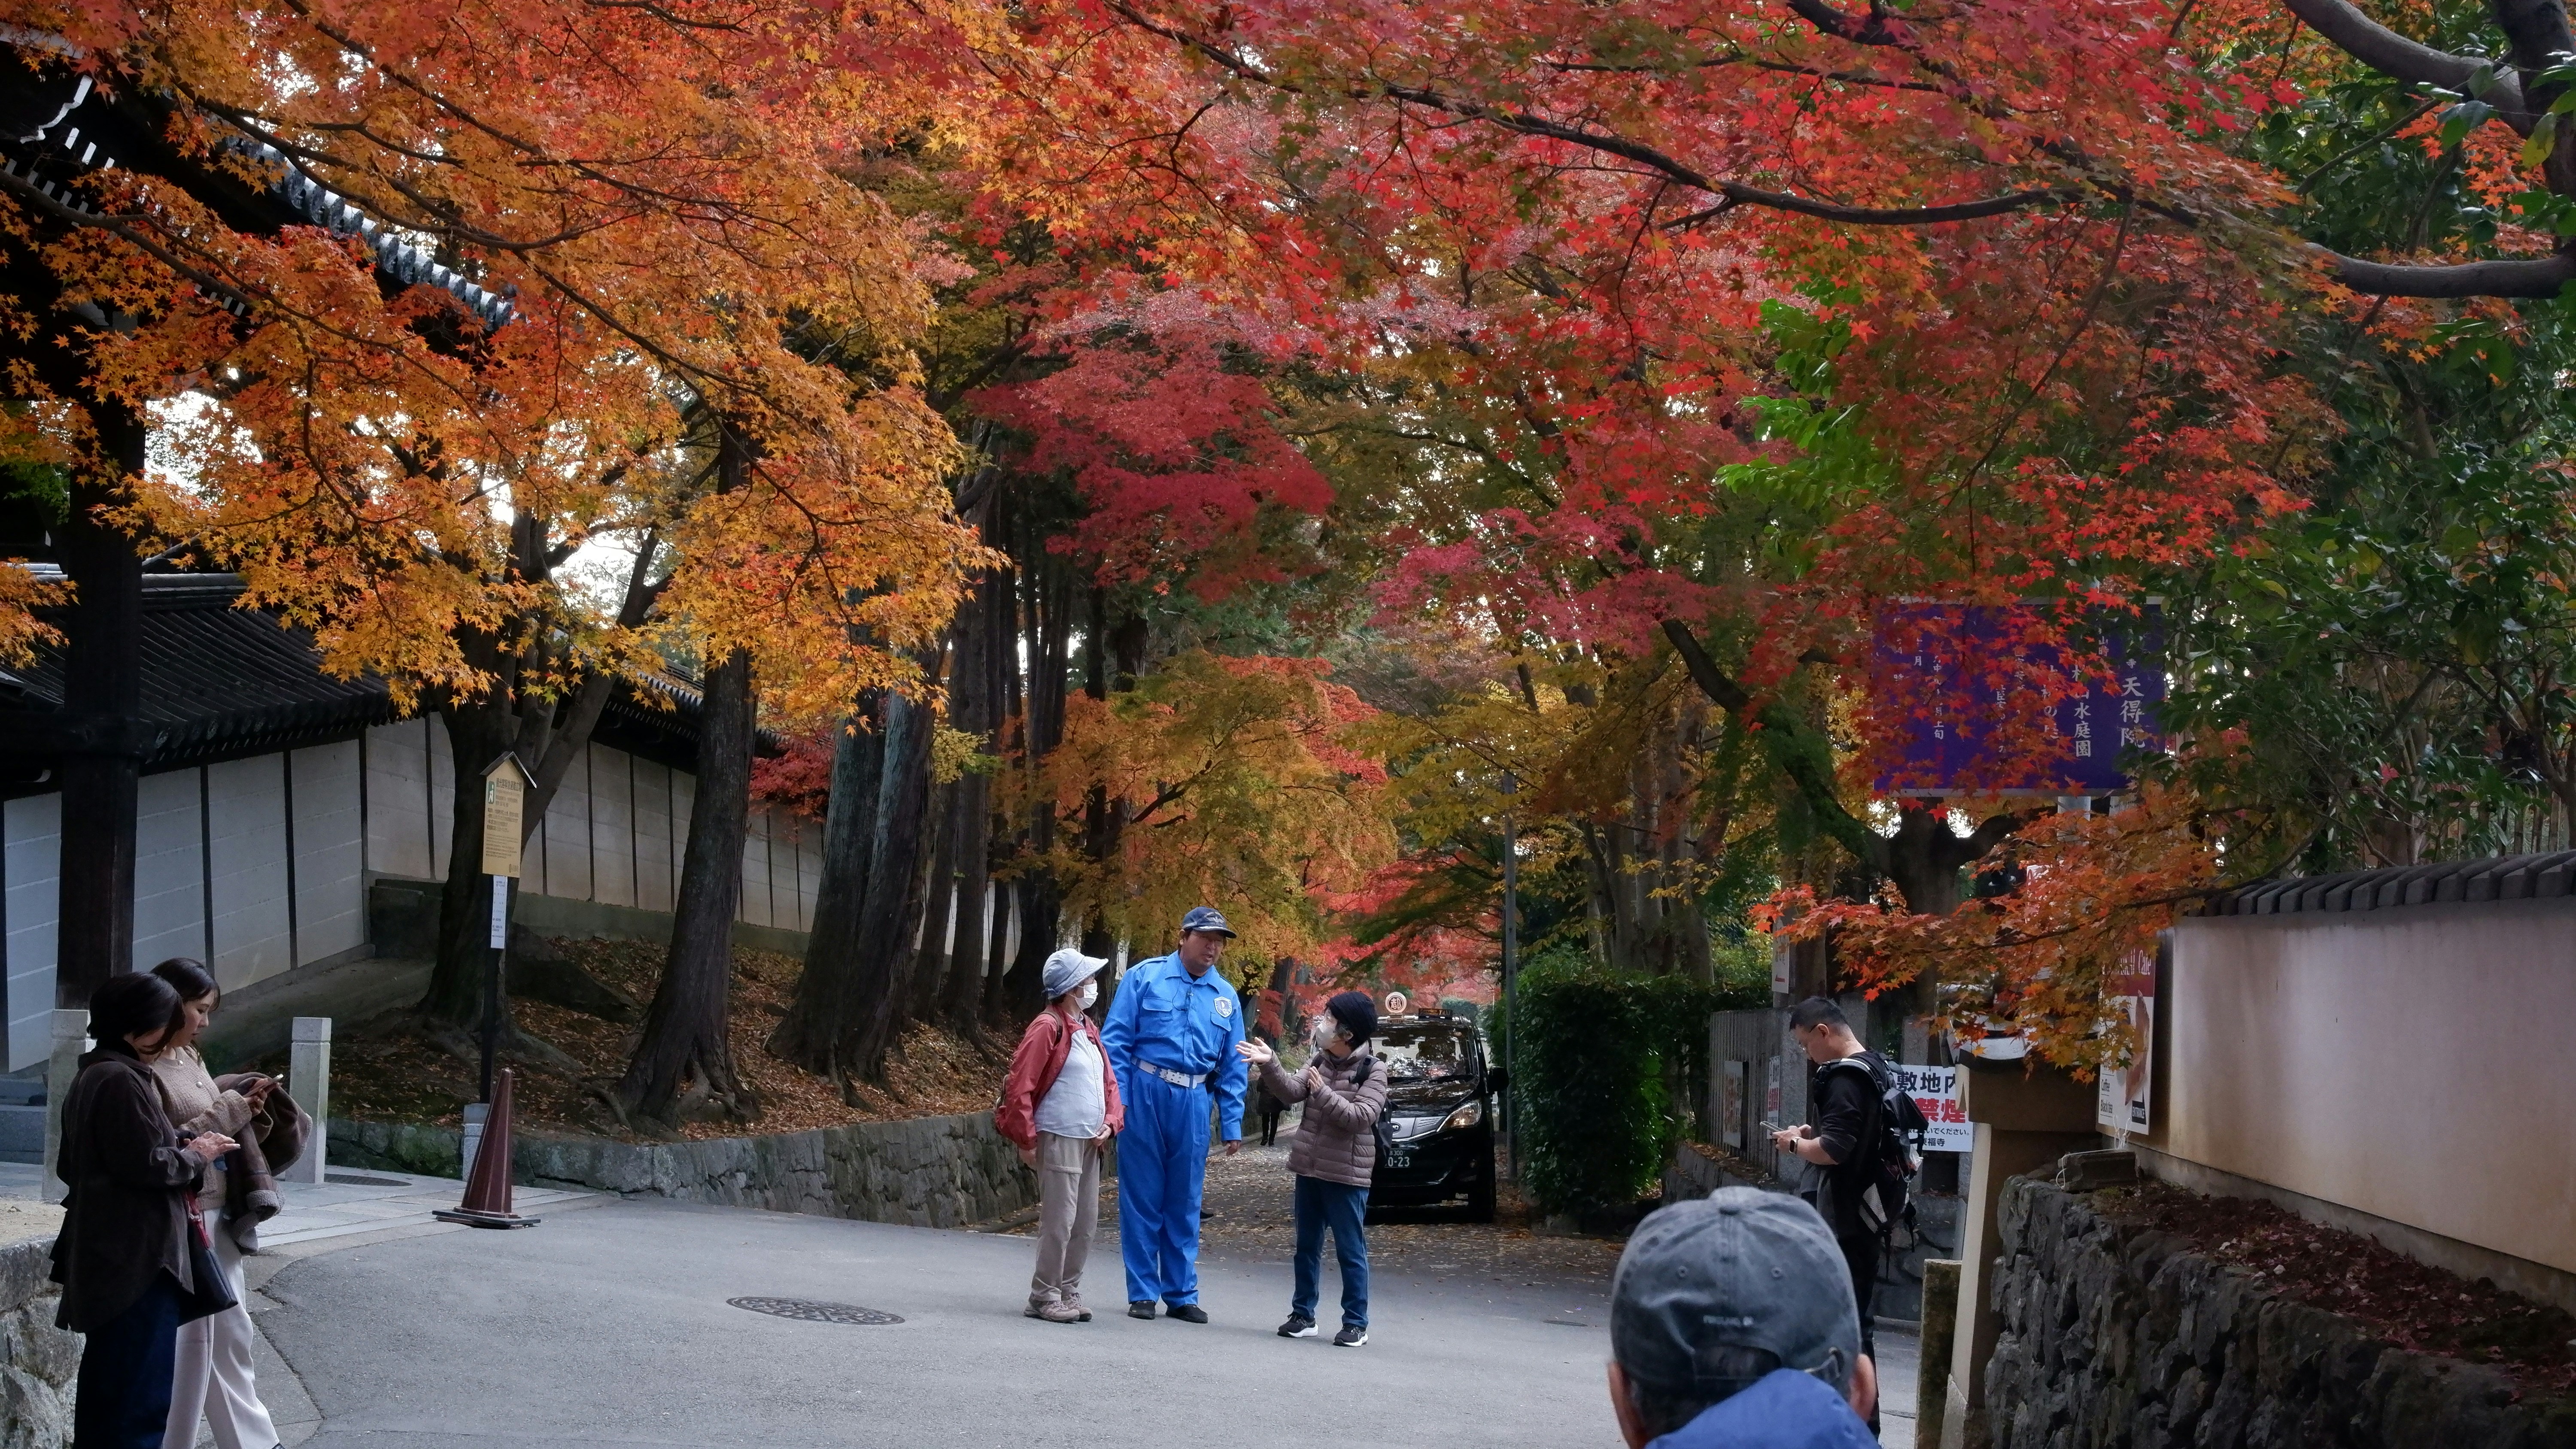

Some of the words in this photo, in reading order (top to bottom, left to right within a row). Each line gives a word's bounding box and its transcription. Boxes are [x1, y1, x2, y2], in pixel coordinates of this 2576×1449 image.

[2119, 676, 2146, 749] 天得院
[1390, 997, 1401, 1009] 都
[1915, 1097, 1965, 1123] 禁煙
